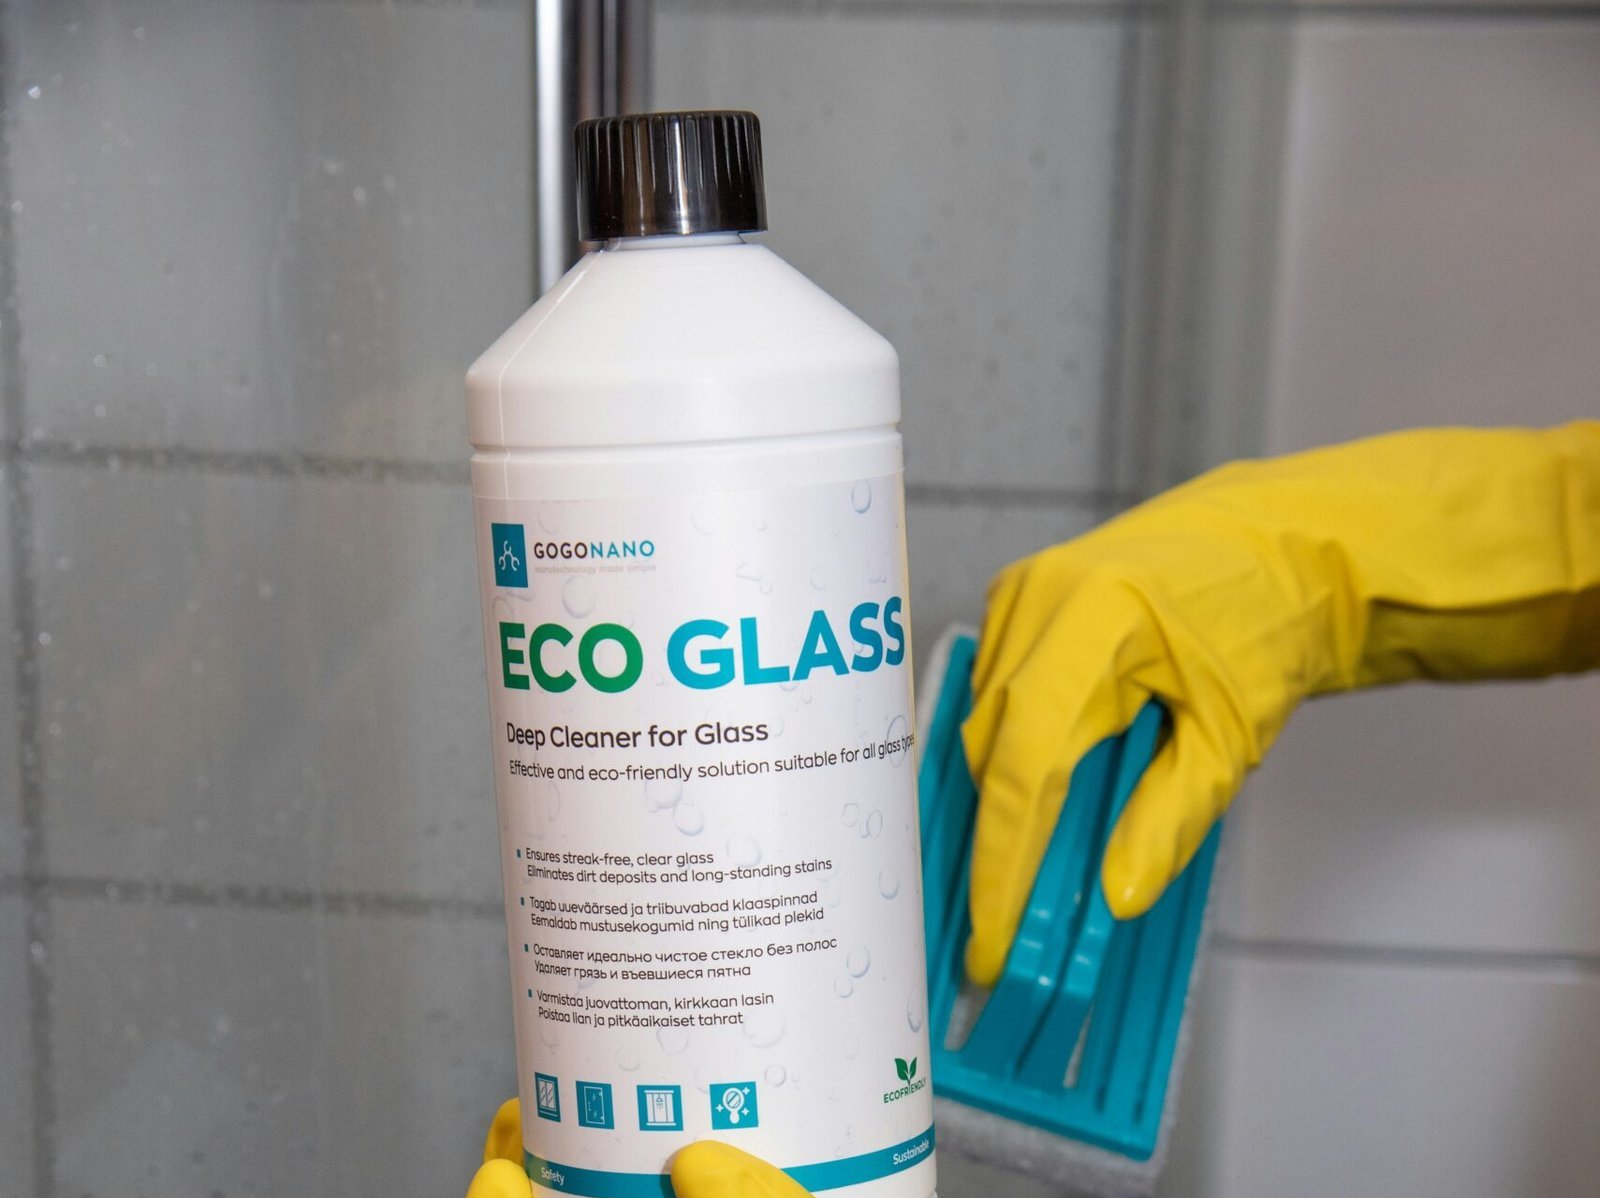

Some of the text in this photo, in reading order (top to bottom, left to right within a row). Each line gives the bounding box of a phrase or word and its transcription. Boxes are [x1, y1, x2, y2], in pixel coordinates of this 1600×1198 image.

[534, 540, 655, 559] GOGONANO
[499, 596, 905, 694] ECO GLASS
[507, 722, 769, 750] Deep Cleaner for Glass
[510, 760, 554, 778] Effective
[557, 765, 584, 780] and
[588, 763, 692, 781] eco-friendly
[698, 760, 769, 778] solution
[774, 751, 837, 771] suitable
[840, 747, 860, 763] for
[863, 742, 876, 759] all
[878, 740, 901, 759] glass
[526, 848, 714, 867] Ensures streak-free, clear glass
[527, 859, 833, 885] Eliminates dirt deposits and long-standing stains
[530, 890, 818, 917] Tagab uueväärsed ja triibuvabad klaaspinnad
[531, 907, 824, 934] Eemaldab mustusekogumid ning tülikad plekid
[533, 938, 838, 964] Оставляет идеально чистое стекло без полос
[534, 959, 751, 980] Удаляет грязь и въевшиеся пятна
[537, 989, 774, 1012] Varmistaa juovattoman, kirkkaan lasin
[538, 1006, 743, 1029] Poistaa lian ja pitkäaikaiset tahrat
[883, 1077, 926, 1103] ECOFRIENDLY
[893, 1140, 929, 1164] Sustainable
[541, 1167, 565, 1185] Safety
